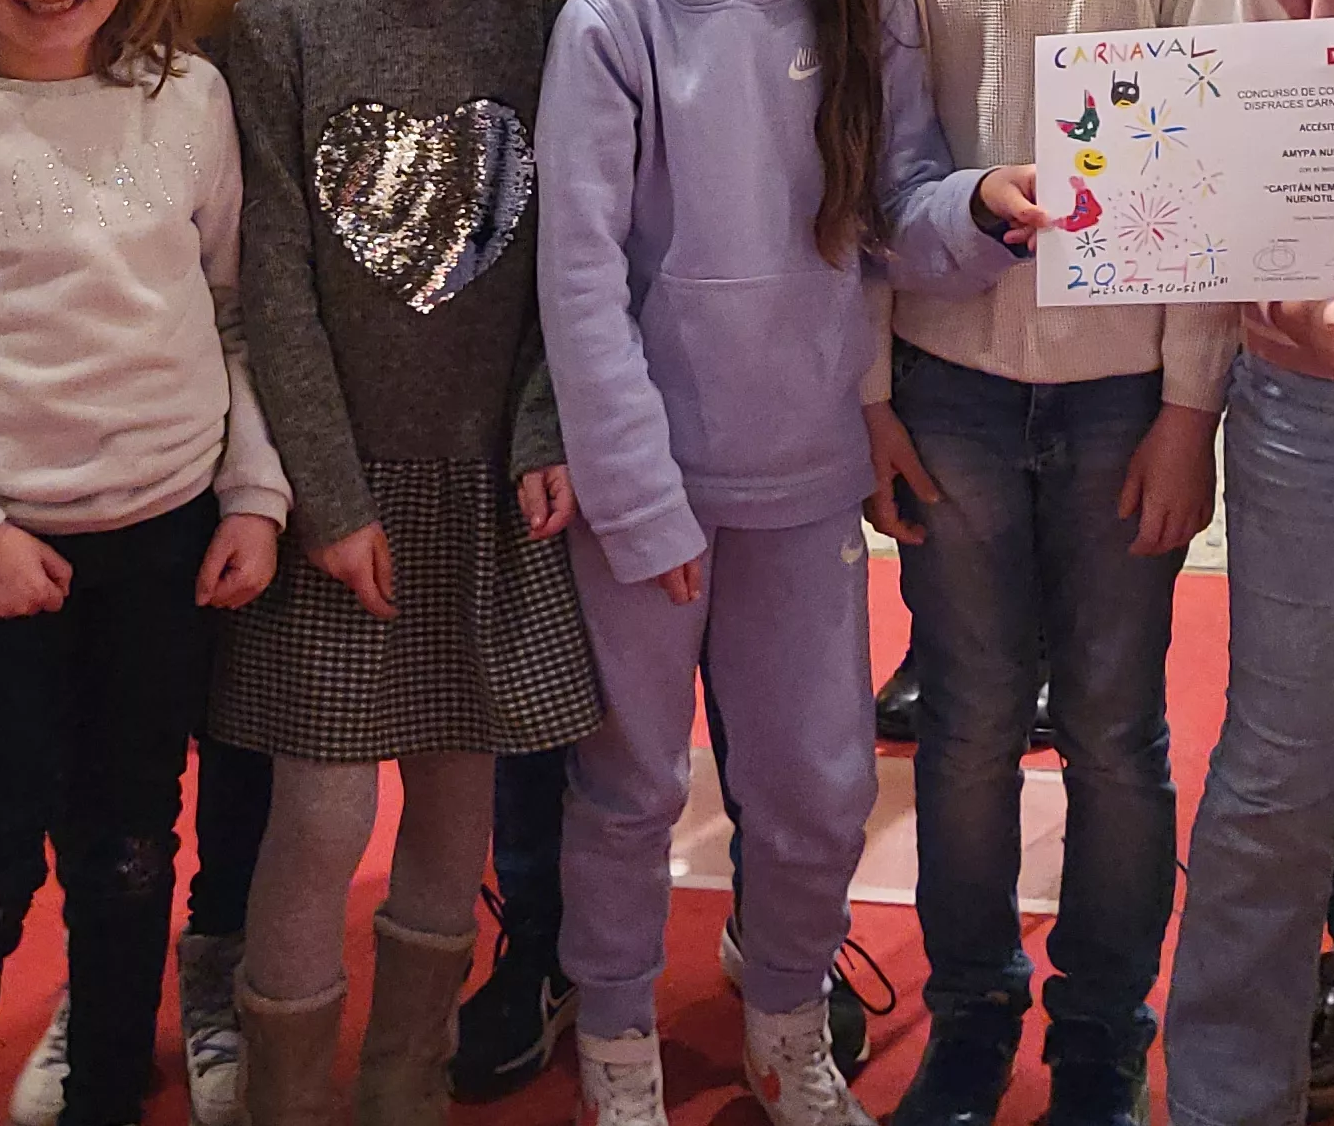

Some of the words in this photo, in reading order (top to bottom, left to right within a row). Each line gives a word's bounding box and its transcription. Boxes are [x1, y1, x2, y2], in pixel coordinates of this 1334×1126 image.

[1054, 36, 1218, 69] CARNAVAL
[1237, 87, 1298, 99] CONCURSO
[1301, 86, 1316, 97] DE
[1244, 98, 1304, 110] DISFRACES
[1282, 148, 1317, 158] AMYPA
[1067, 256, 1189, 290] 2024
